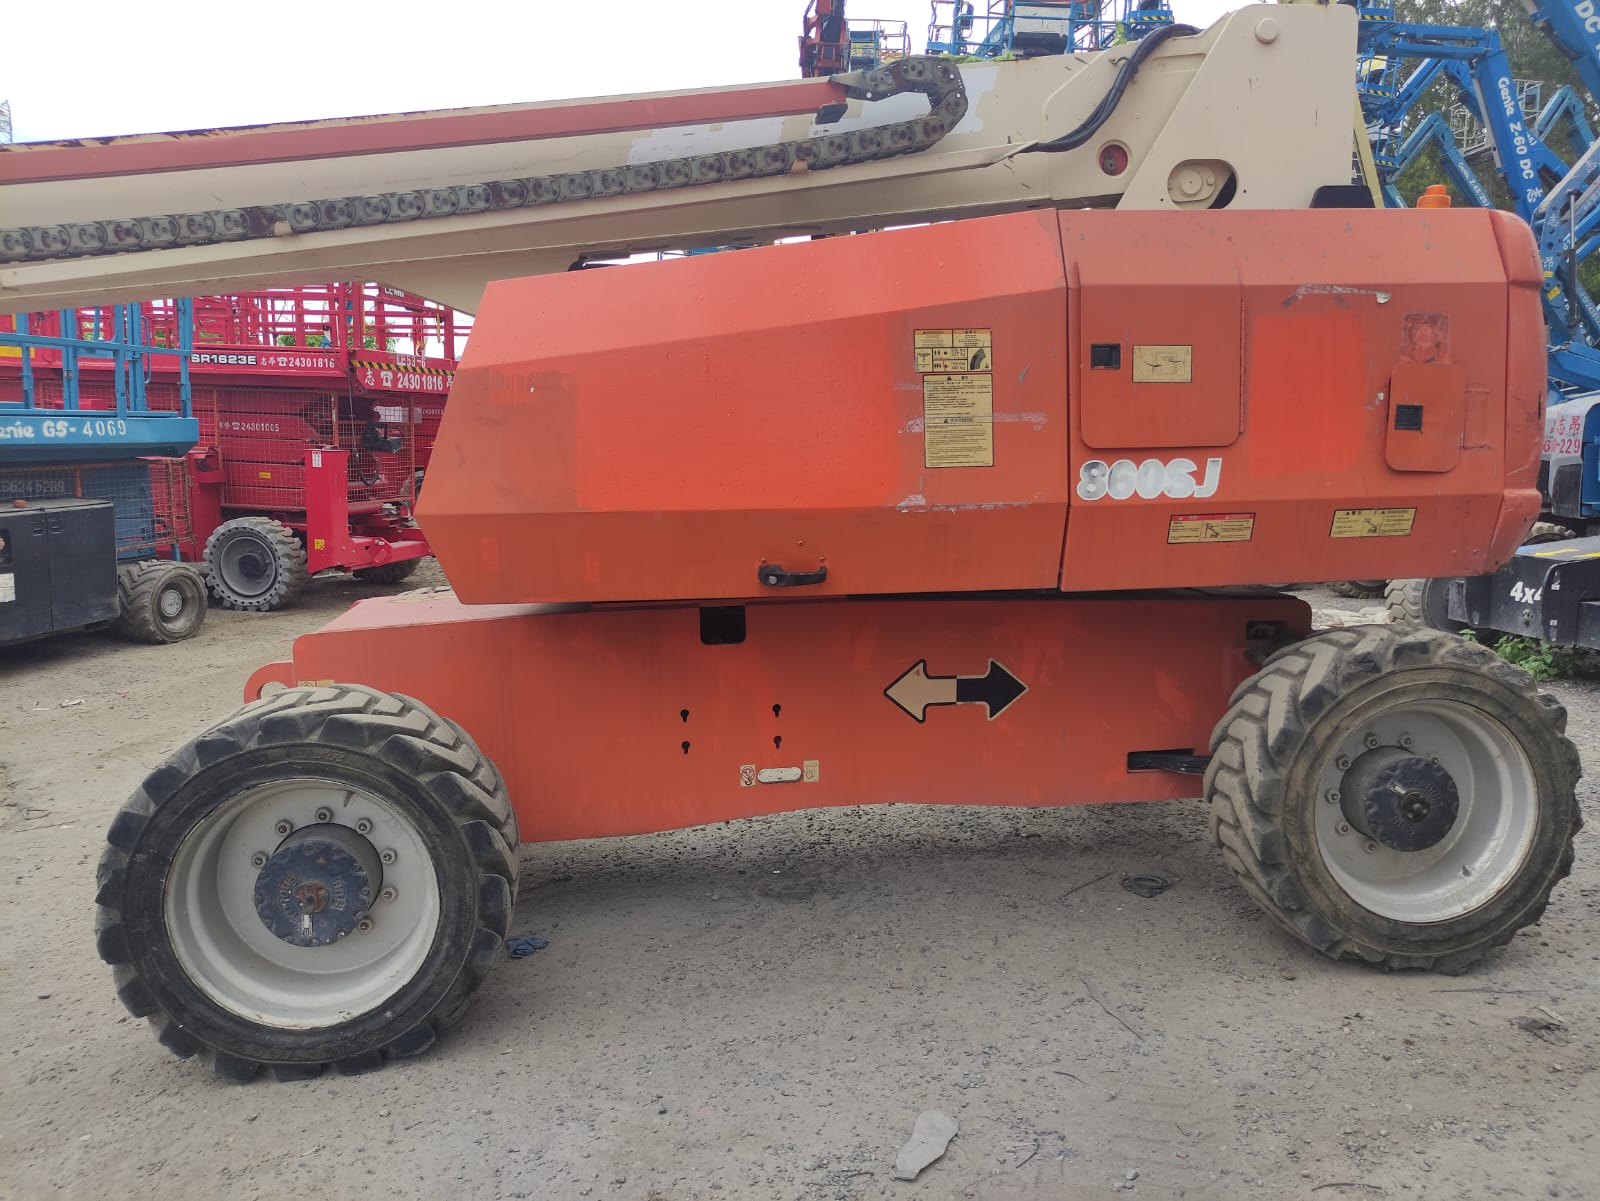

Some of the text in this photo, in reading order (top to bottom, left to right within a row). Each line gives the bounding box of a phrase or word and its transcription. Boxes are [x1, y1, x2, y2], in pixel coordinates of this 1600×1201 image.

[1574, 0, 1600, 34] DC
[1497, 76, 1515, 118] Genie
[1509, 121, 1528, 156] Z-60
[1519, 158, 1535, 180] DC
[190, 353, 257, 365] SR1623E
[289, 357, 335, 368] 24301816
[397, 372, 443, 391] 24301816
[82, 420, 127, 437] 4069
[1076, 457, 1223, 501] 860SJ
